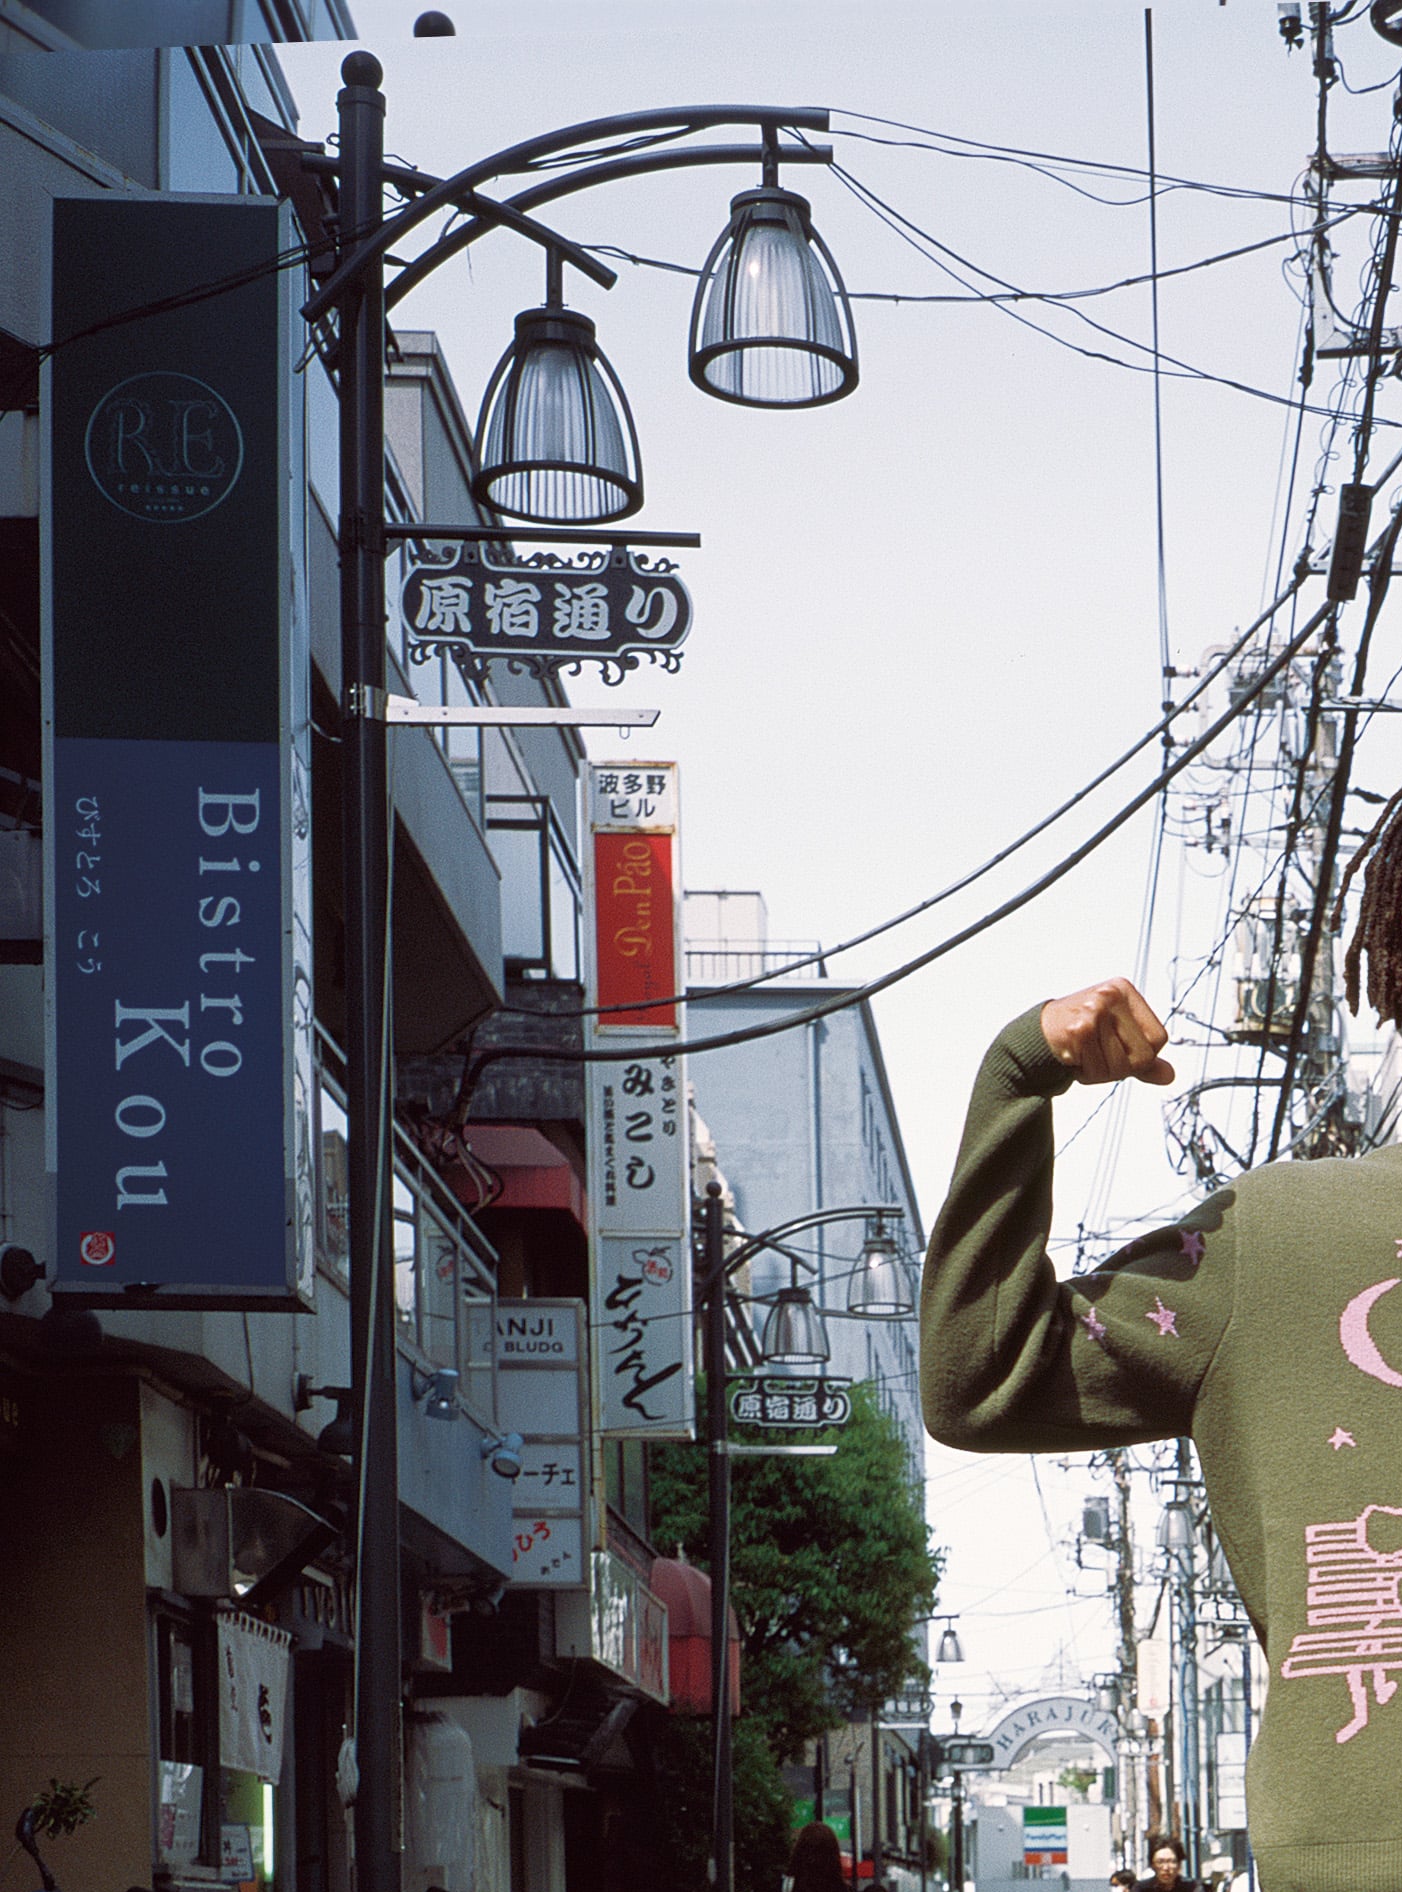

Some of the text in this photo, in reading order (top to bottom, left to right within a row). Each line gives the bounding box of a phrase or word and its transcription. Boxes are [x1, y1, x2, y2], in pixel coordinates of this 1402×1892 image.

[415, 575, 678, 640] 原宿通り
[598, 774, 667, 796] 波多野
[610, 798, 656, 819] ビル
[75, 796, 102, 898] びすとろ
[198, 786, 262, 1077] Bistro
[114, 999, 190, 1211] Kou
[622, 1064, 655, 1190] みこし
[738, 1394, 845, 1420] 原宿通り
